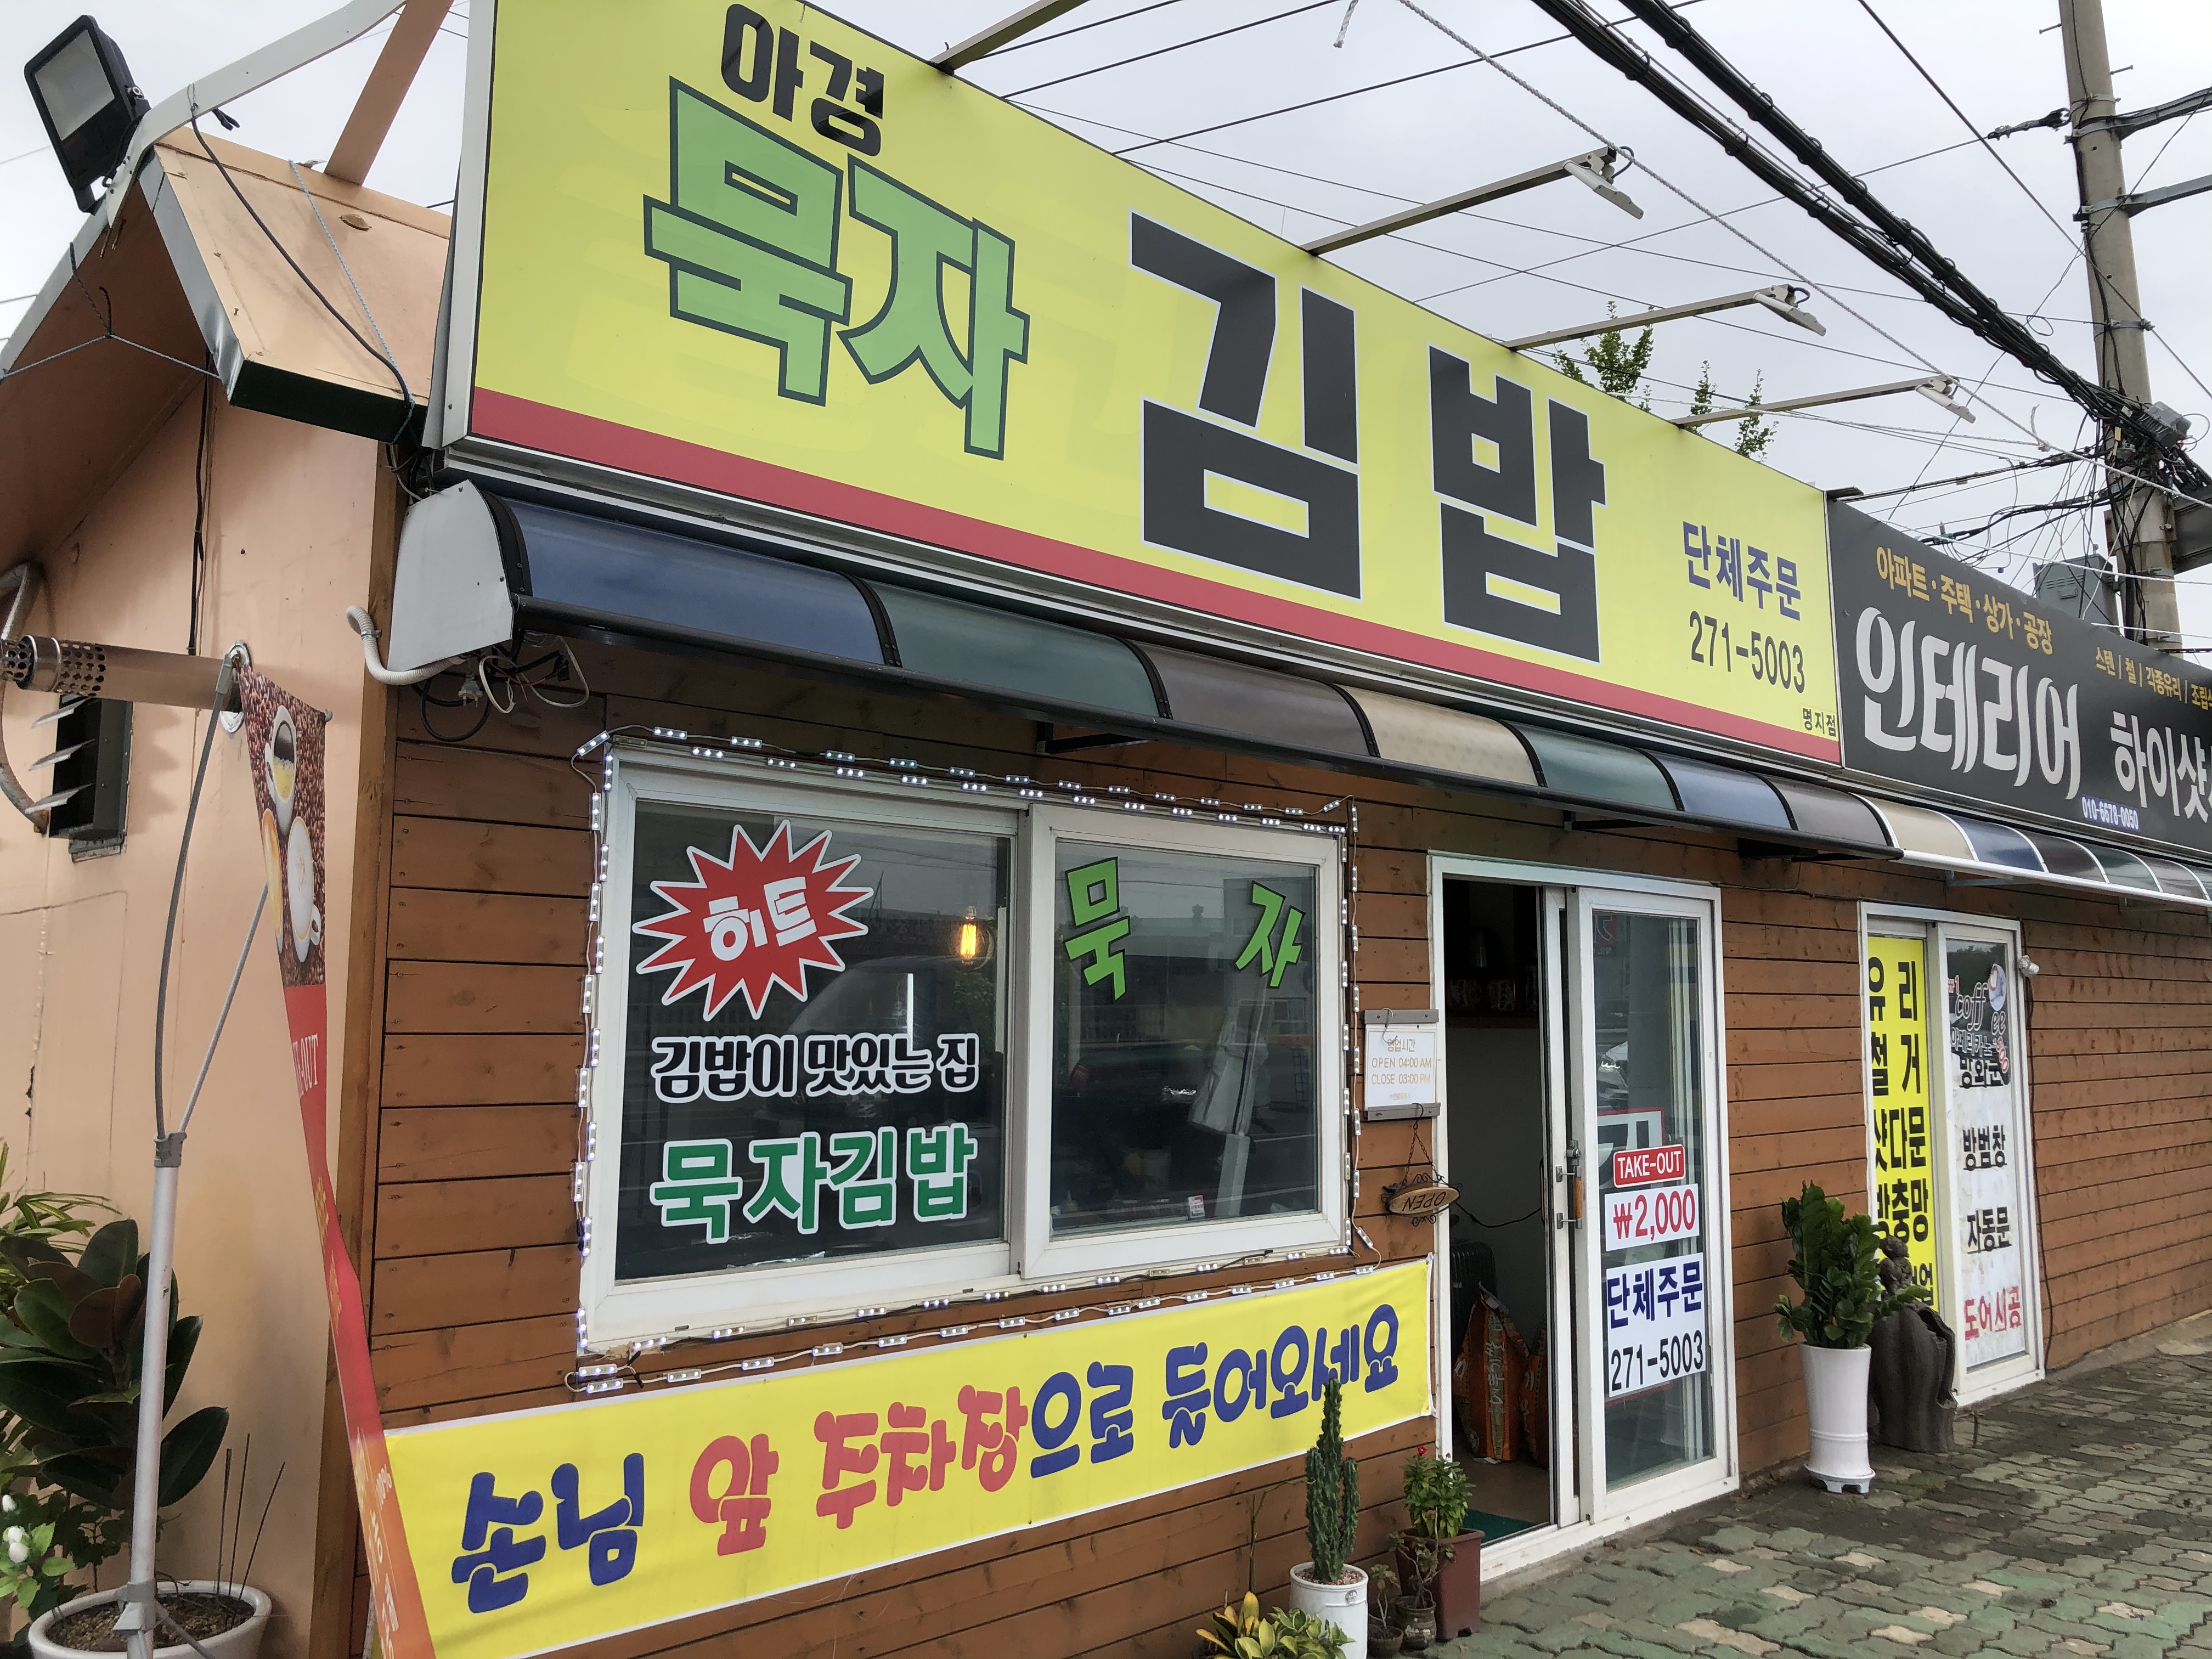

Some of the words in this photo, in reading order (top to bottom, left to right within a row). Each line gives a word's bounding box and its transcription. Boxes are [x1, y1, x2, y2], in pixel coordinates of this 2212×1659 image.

[721, 3, 884, 156] 아경
[643, 75, 1030, 460] 묵자
[1130, 208, 1606, 664] 김밥
[1683, 521, 1801, 621] 단체주문
[1689, 611, 1805, 693] 271-5003
[1803, 707, 1836, 737] 명지점
[1857, 607, 2081, 800] 인테리어
[2110, 711, 2212, 823] 하이샷
[2082, 797, 2139, 830] 010-6678-0050
[703, 876, 817, 961] 히트
[651, 1034, 799, 1103] 김밥이
[804, 1033, 934, 1096] 맛있는
[937, 1033, 979, 1092] 집
[1372, 1058, 1396, 1068] OPEN
[1399, 1057, 1419, 1068] 04:00
[1420, 1058, 1432, 1068] AM
[1387, 1039, 1416, 1052] 영업시간
[1372, 1074, 1395, 1085] CLOSE
[1399, 1074, 1419, 1084] 03:00
[1420, 1074, 1431, 1084] PM
[1617, 1150, 1681, 1179] TAKE-OUT
[1963, 1125, 2007, 1171] 방범창
[650, 1122, 978, 1244] 묵자김밥
[1402, 1191, 1447, 1212] OPEN
[1613, 1189, 1696, 1242] ₩2,000
[1967, 1206, 2012, 1254] 자동문
[1607, 1261, 1703, 1329] 단체주문
[1964, 1285, 2022, 1341] 도어시공
[1611, 1329, 1703, 1392] 271-5003
[451, 1452, 645, 1613] 손님
[690, 1433, 779, 1556] 앞
[814, 1361, 1135, 1530] 주차장으로
[1161, 1304, 1399, 1449] 들어오세요
